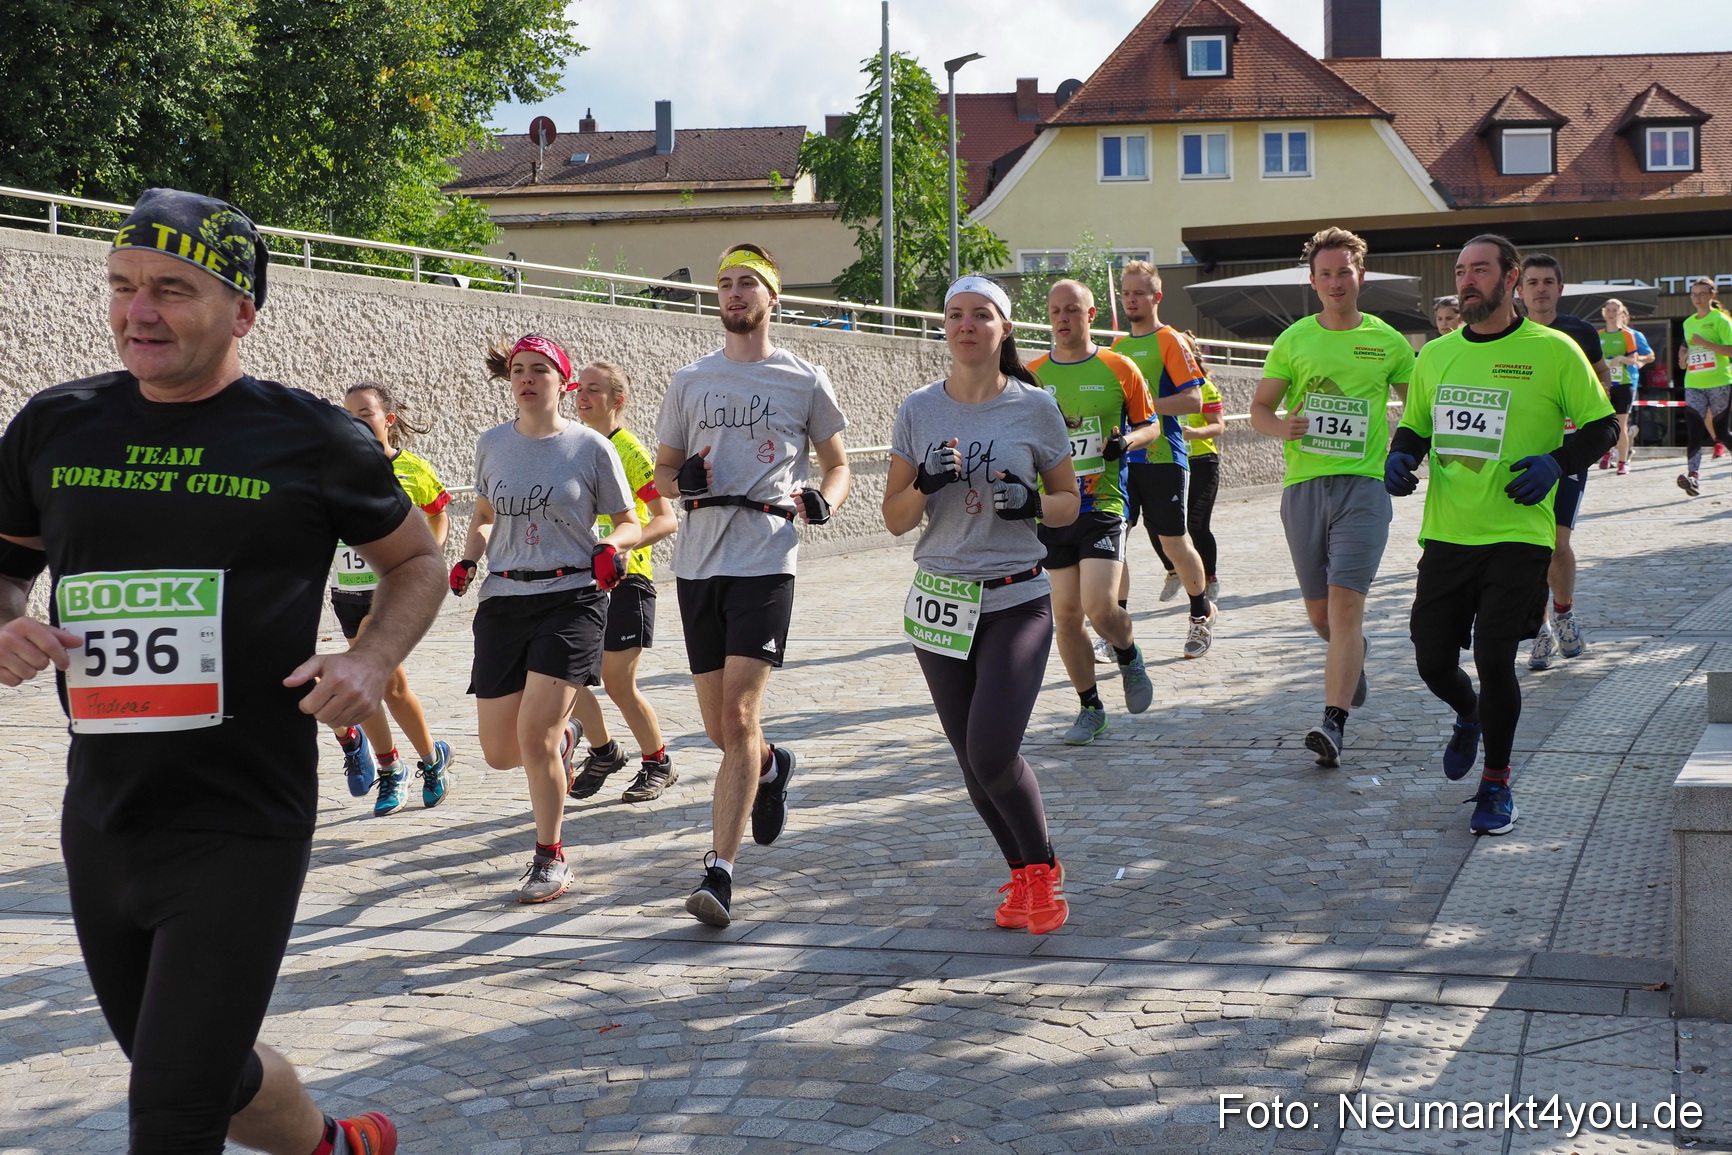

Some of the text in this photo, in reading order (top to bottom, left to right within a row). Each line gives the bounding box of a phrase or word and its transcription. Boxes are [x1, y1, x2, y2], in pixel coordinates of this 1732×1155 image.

[1691, 353, 1707, 364] 531
[1308, 395, 1364, 415] BOCK
[1438, 387, 1502, 408] BOCK
[1315, 416, 1352, 436] 134
[1446, 409, 1486, 433] 194
[1312, 438, 1351, 450] PHILLIP
[126, 445, 204, 466] TEAM
[51, 466, 271, 500] FORREST GUMP
[915, 568, 974, 600] BOCK
[65, 577, 205, 616] BOCK
[916, 595, 959, 628] 105
[913, 625, 952, 646] SARAH
[84, 627, 179, 677] 536
[86, 692, 151, 715] Andreas
